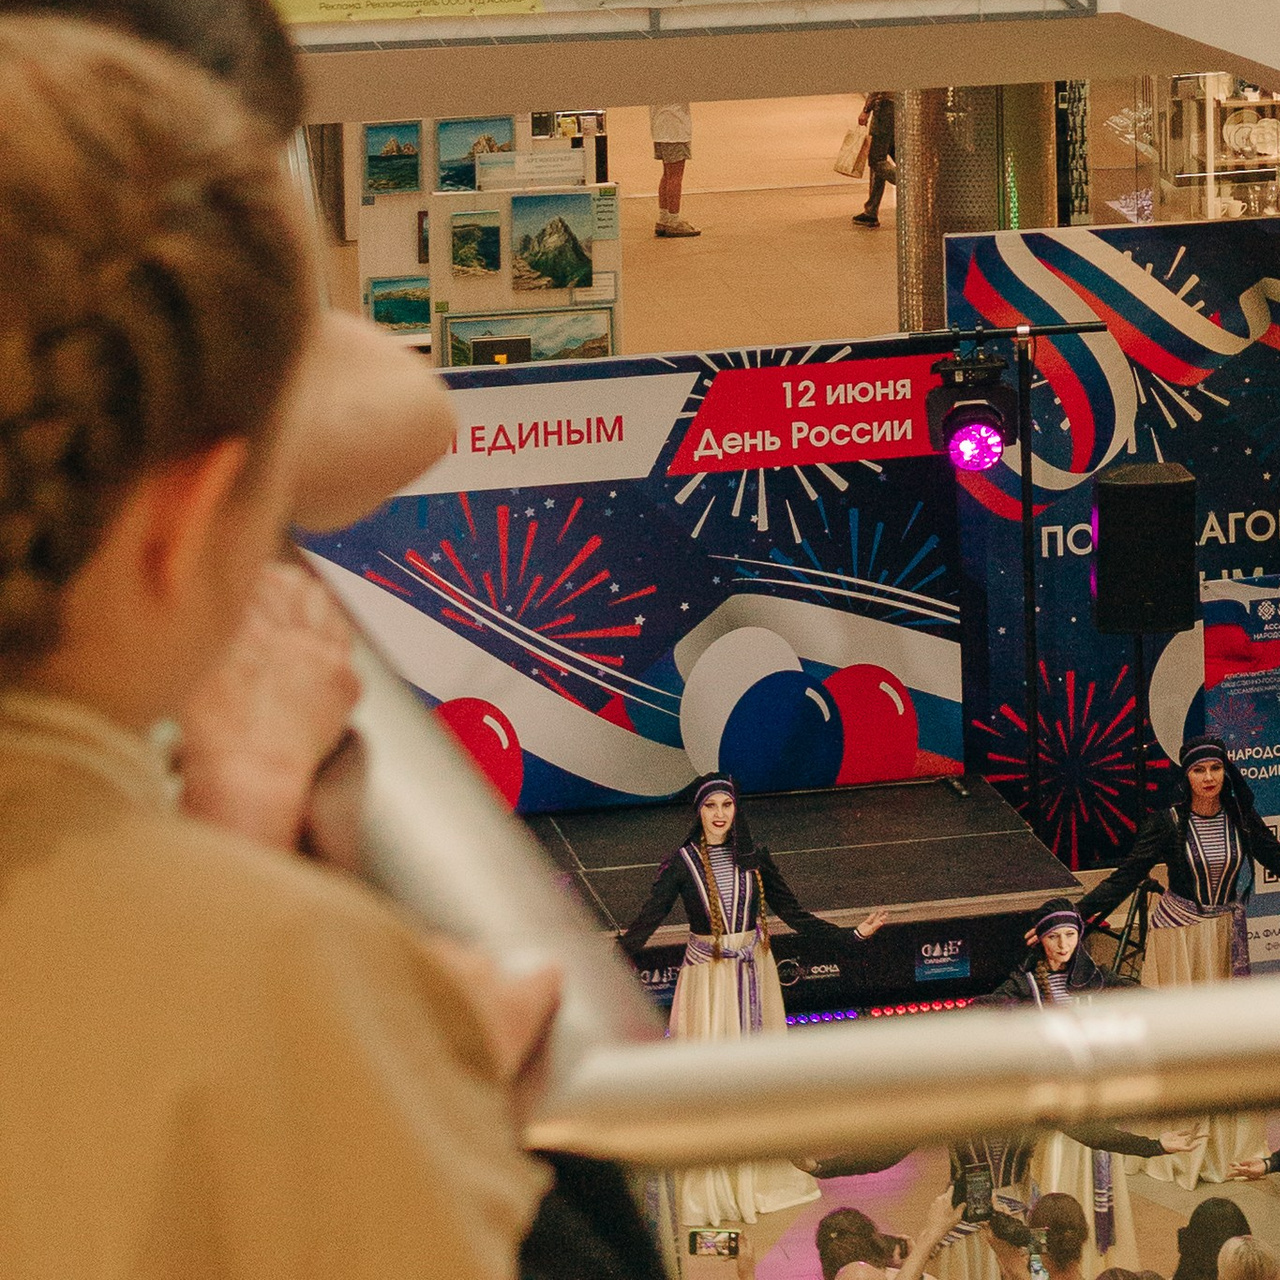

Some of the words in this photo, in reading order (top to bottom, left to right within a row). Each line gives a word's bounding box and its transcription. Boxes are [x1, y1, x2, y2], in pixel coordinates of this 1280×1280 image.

[782, 380, 816, 409] 12
[826, 378, 912, 406] июня
[470, 415, 624, 456] ЕДИНЫМ
[693, 428, 781, 462] День
[791, 419, 913, 450] России
[1041, 523, 1093, 558] ПО
